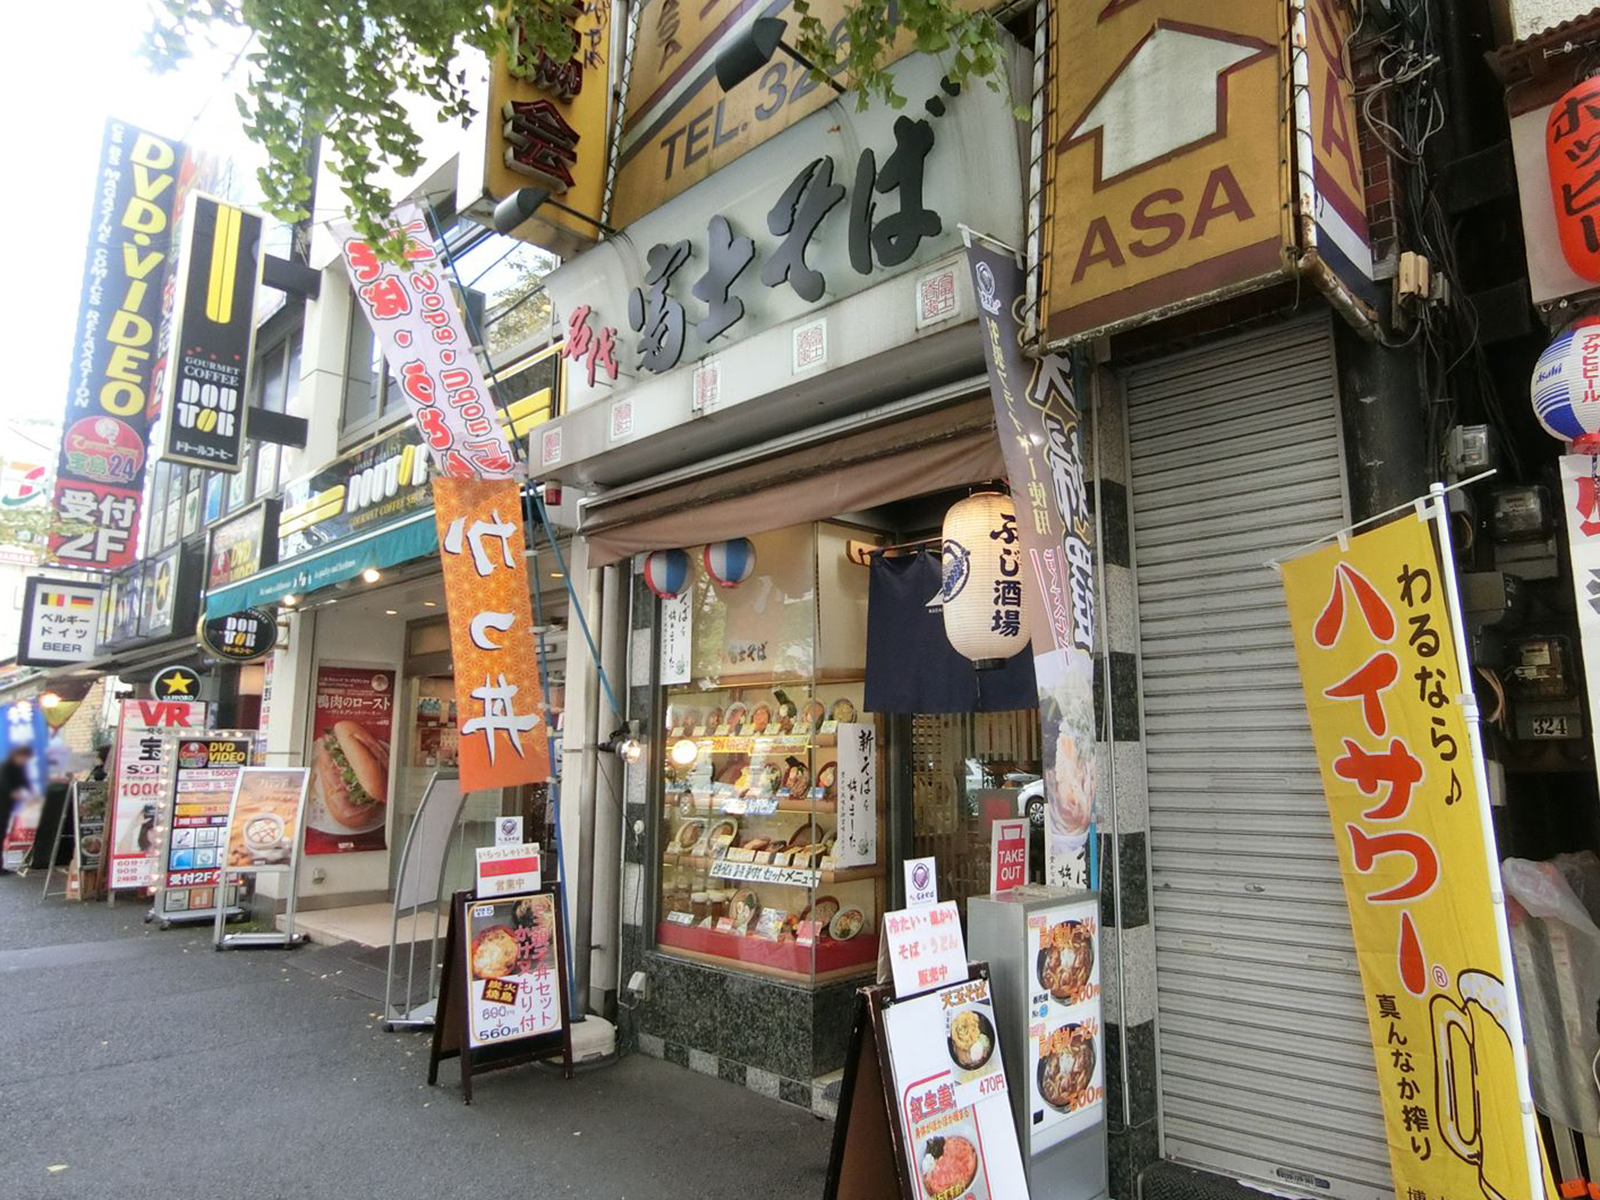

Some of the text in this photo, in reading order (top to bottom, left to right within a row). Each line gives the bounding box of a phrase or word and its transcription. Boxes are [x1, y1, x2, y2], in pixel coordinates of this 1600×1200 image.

[628, 75, 961, 374] 富士そば
[1070, 164, 1256, 286] ASA
[74, 309, 100, 409] RELAXATION
[184, 356, 241, 375] GOURMET
[183, 365, 240, 387] COFFEE
[1535, 362, 1564, 385] Asahi
[175, 440, 234, 460] ドトールコーヒー
[59, 488, 137, 529] 受付
[55, 526, 130, 562] 2F
[989, 513, 1022, 638] ふじ酒場
[41, 613, 90, 624] ベルギー
[42, 626, 88, 639] ドイツ
[42, 642, 82, 653] BEER
[1396, 563, 1459, 762] わるなら
[138, 700, 191, 728] VR
[317, 695, 391, 711] 鴨肉のロースト
[1533, 716, 1567, 737] 324
[209, 742, 236, 752] DVD
[209, 751, 246, 762] VIDEO
[1313, 560, 1441, 996] ハイサワー
[998, 848, 1024, 864] TAKE
[1001, 865, 1022, 881] OUT
[495, 878, 525, 892] 営業中
[917, 964, 948, 987] 販売中
[940, 980, 989, 1011] 天玉そば
[479, 1025, 520, 1041] 560円
[978, 1073, 1005, 1096] 470円
[1375, 994, 1432, 1162] 真んなか搾り
